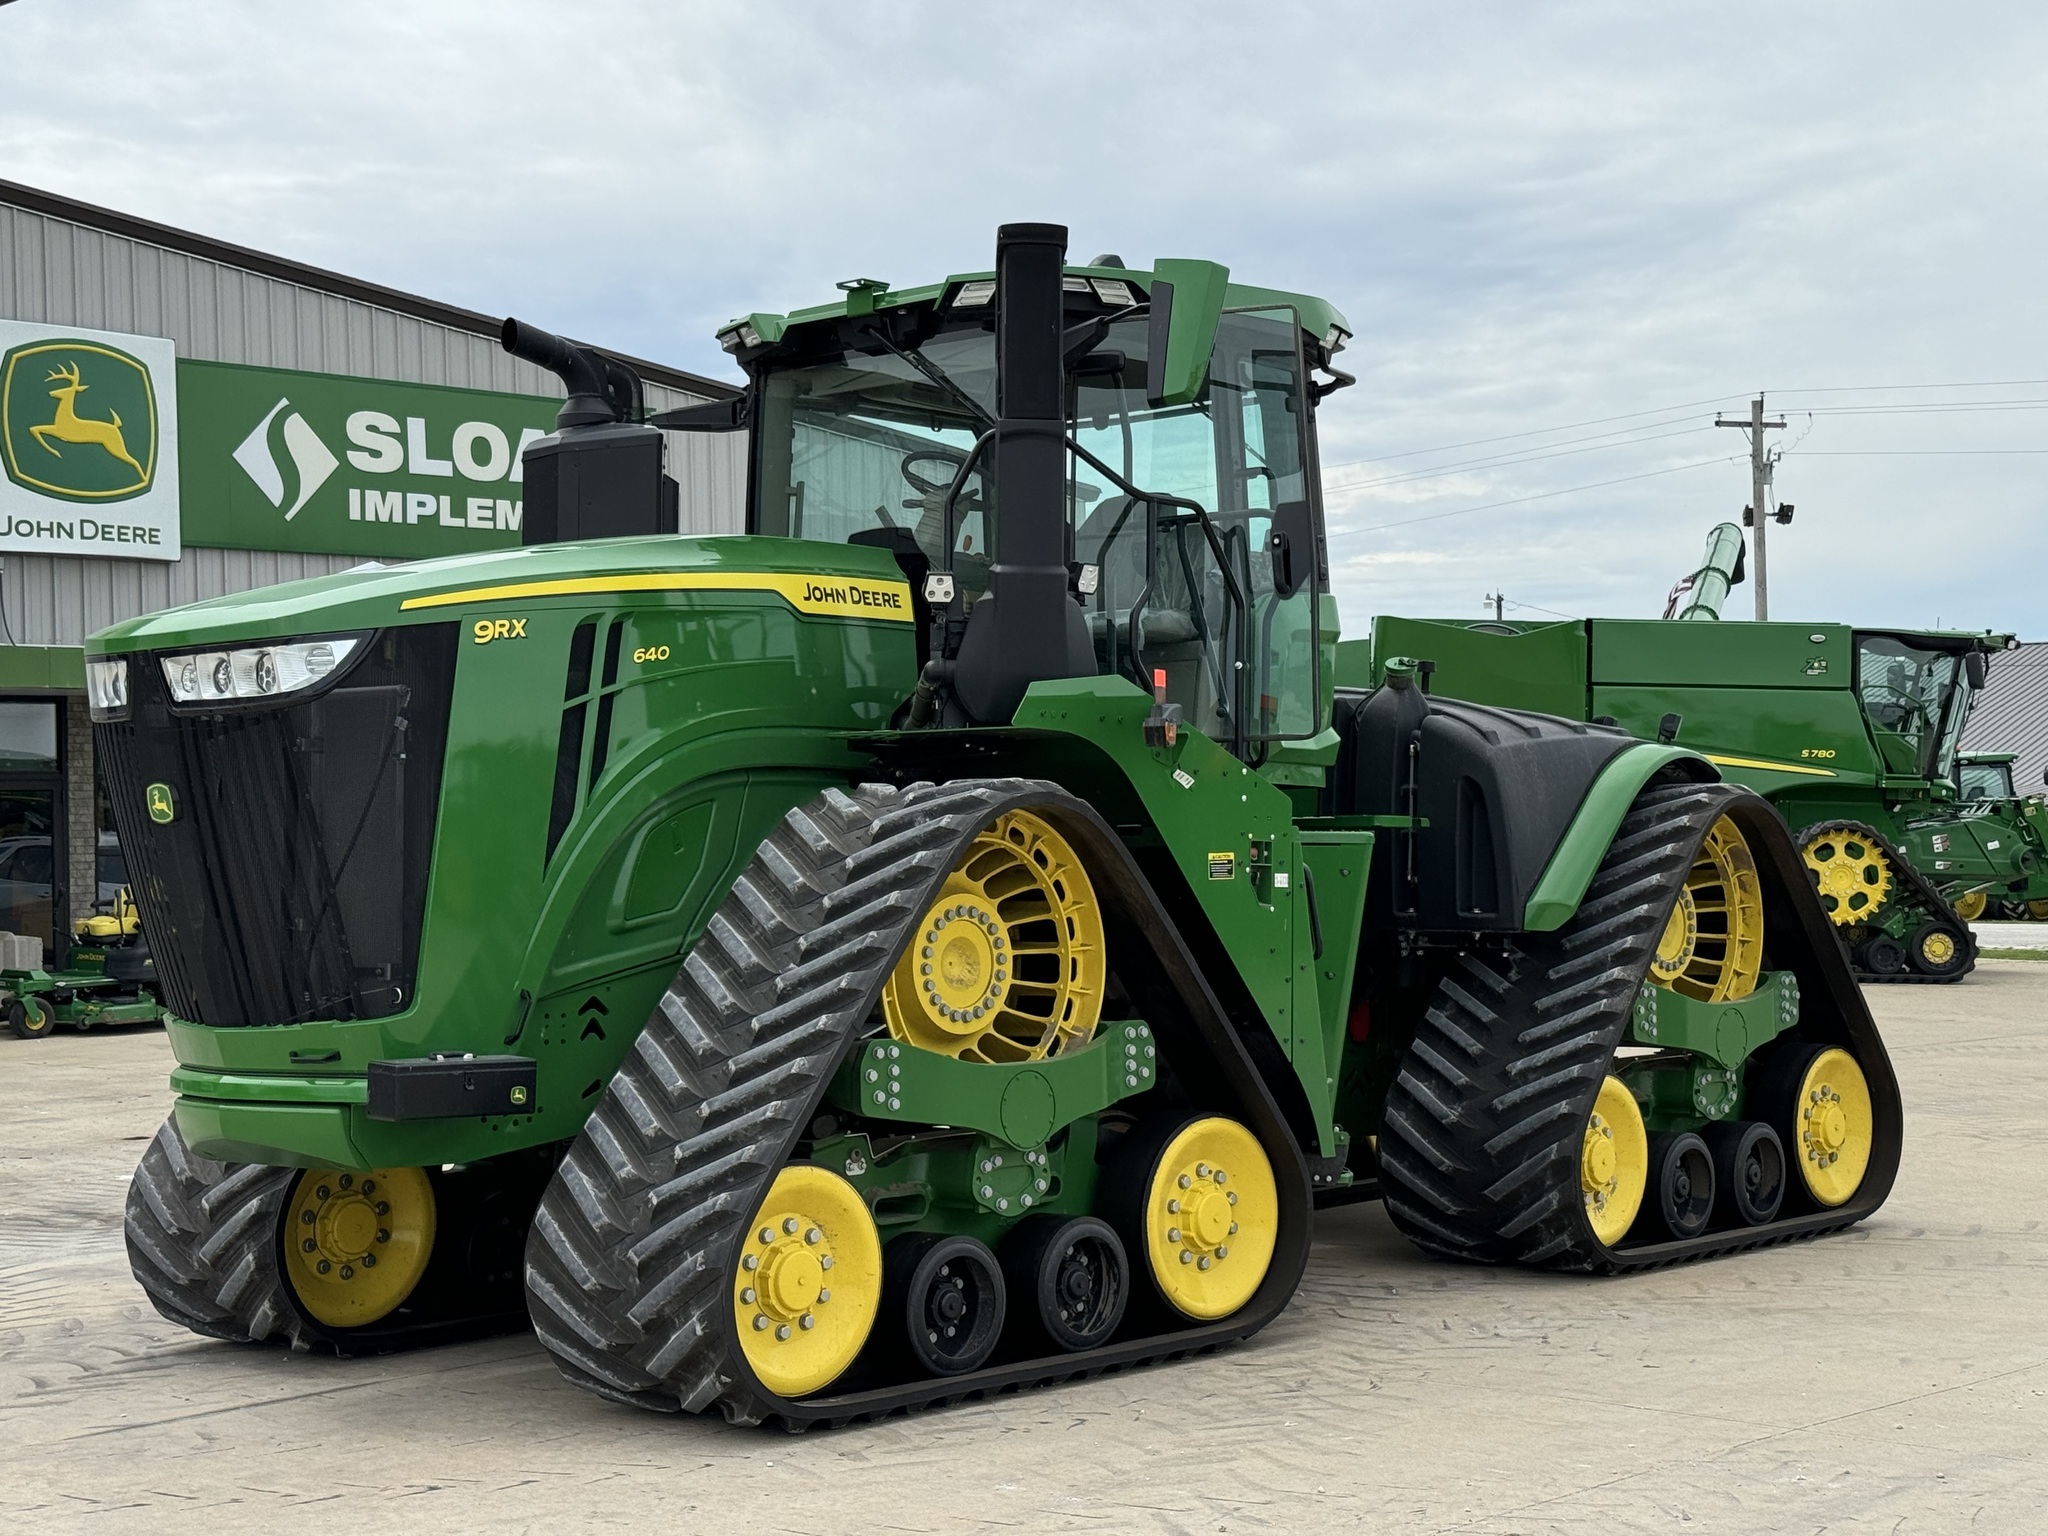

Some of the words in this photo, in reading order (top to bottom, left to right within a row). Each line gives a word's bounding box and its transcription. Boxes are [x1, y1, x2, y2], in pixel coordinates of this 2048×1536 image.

[0, 515, 74, 539] JOHN
[80, 519, 161, 545] DEERE
[803, 582, 847, 604] JOHN
[849, 586, 902, 608] DEERE
[473, 618, 528, 645] 9RX
[632, 645, 671, 664] 640
